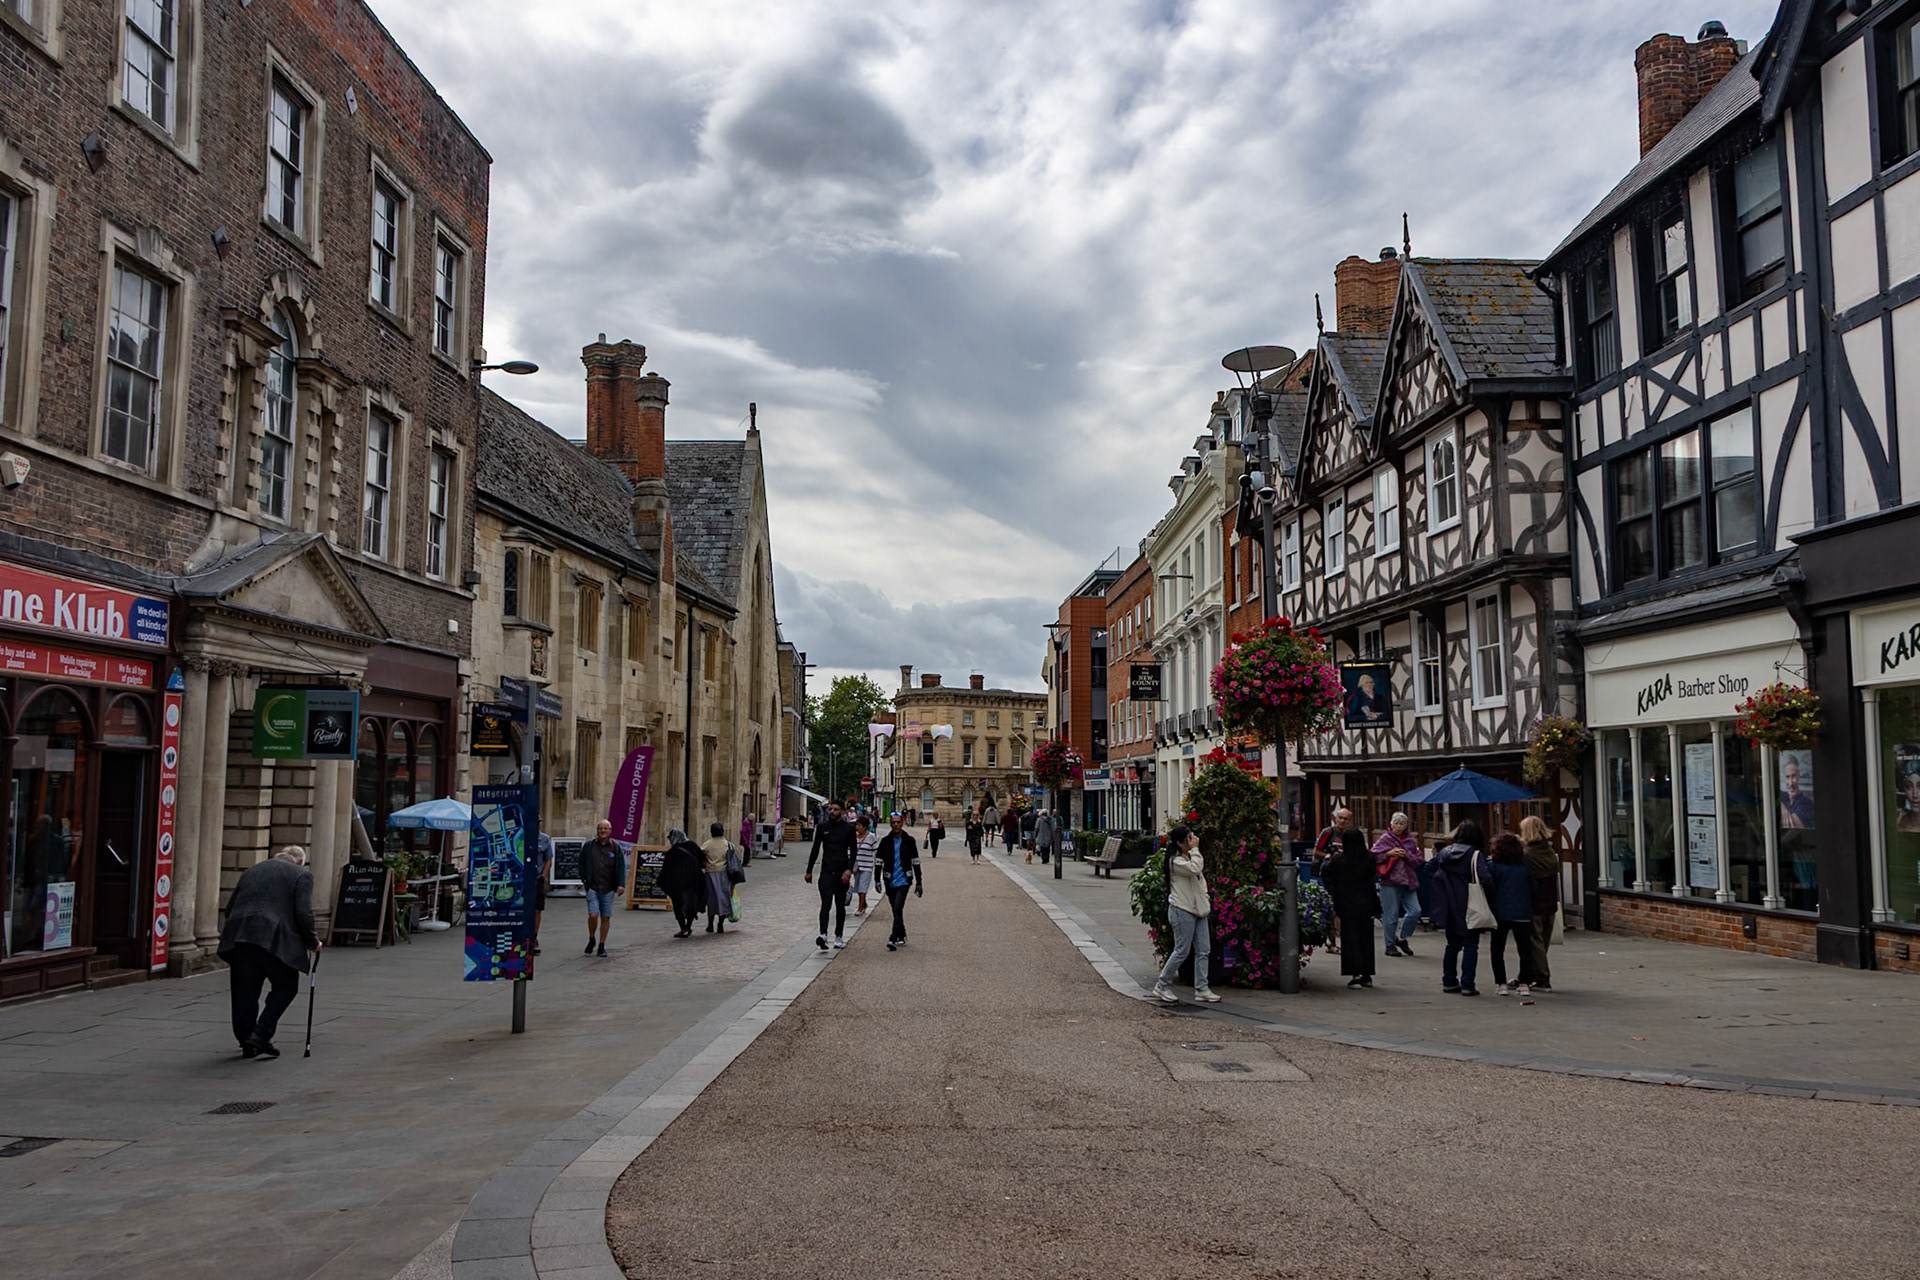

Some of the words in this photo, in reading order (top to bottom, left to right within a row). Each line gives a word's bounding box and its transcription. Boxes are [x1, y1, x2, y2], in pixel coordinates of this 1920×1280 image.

[0, 588, 44, 624] ne
[53, 588, 124, 639] Klub
[137, 605, 148, 616] We
[148, 607, 161, 619] deal
[161, 610, 168, 620] in
[137, 618, 145, 628] all
[145, 619, 161, 631] kinds
[5, 646, 15, 658] buy
[15, 648, 26, 658] and
[6, 658, 25, 669] phones
[1131, 679, 1160, 687] COUNTY
[1637, 673, 1673, 716] KARA
[1677, 677, 1716, 699] Barber
[1718, 673, 1749, 697] Shop
[477, 789, 521, 799] GLOUCESTER
[623, 789, 639, 837] Tearoom
[631, 754, 646, 788] OPEN
